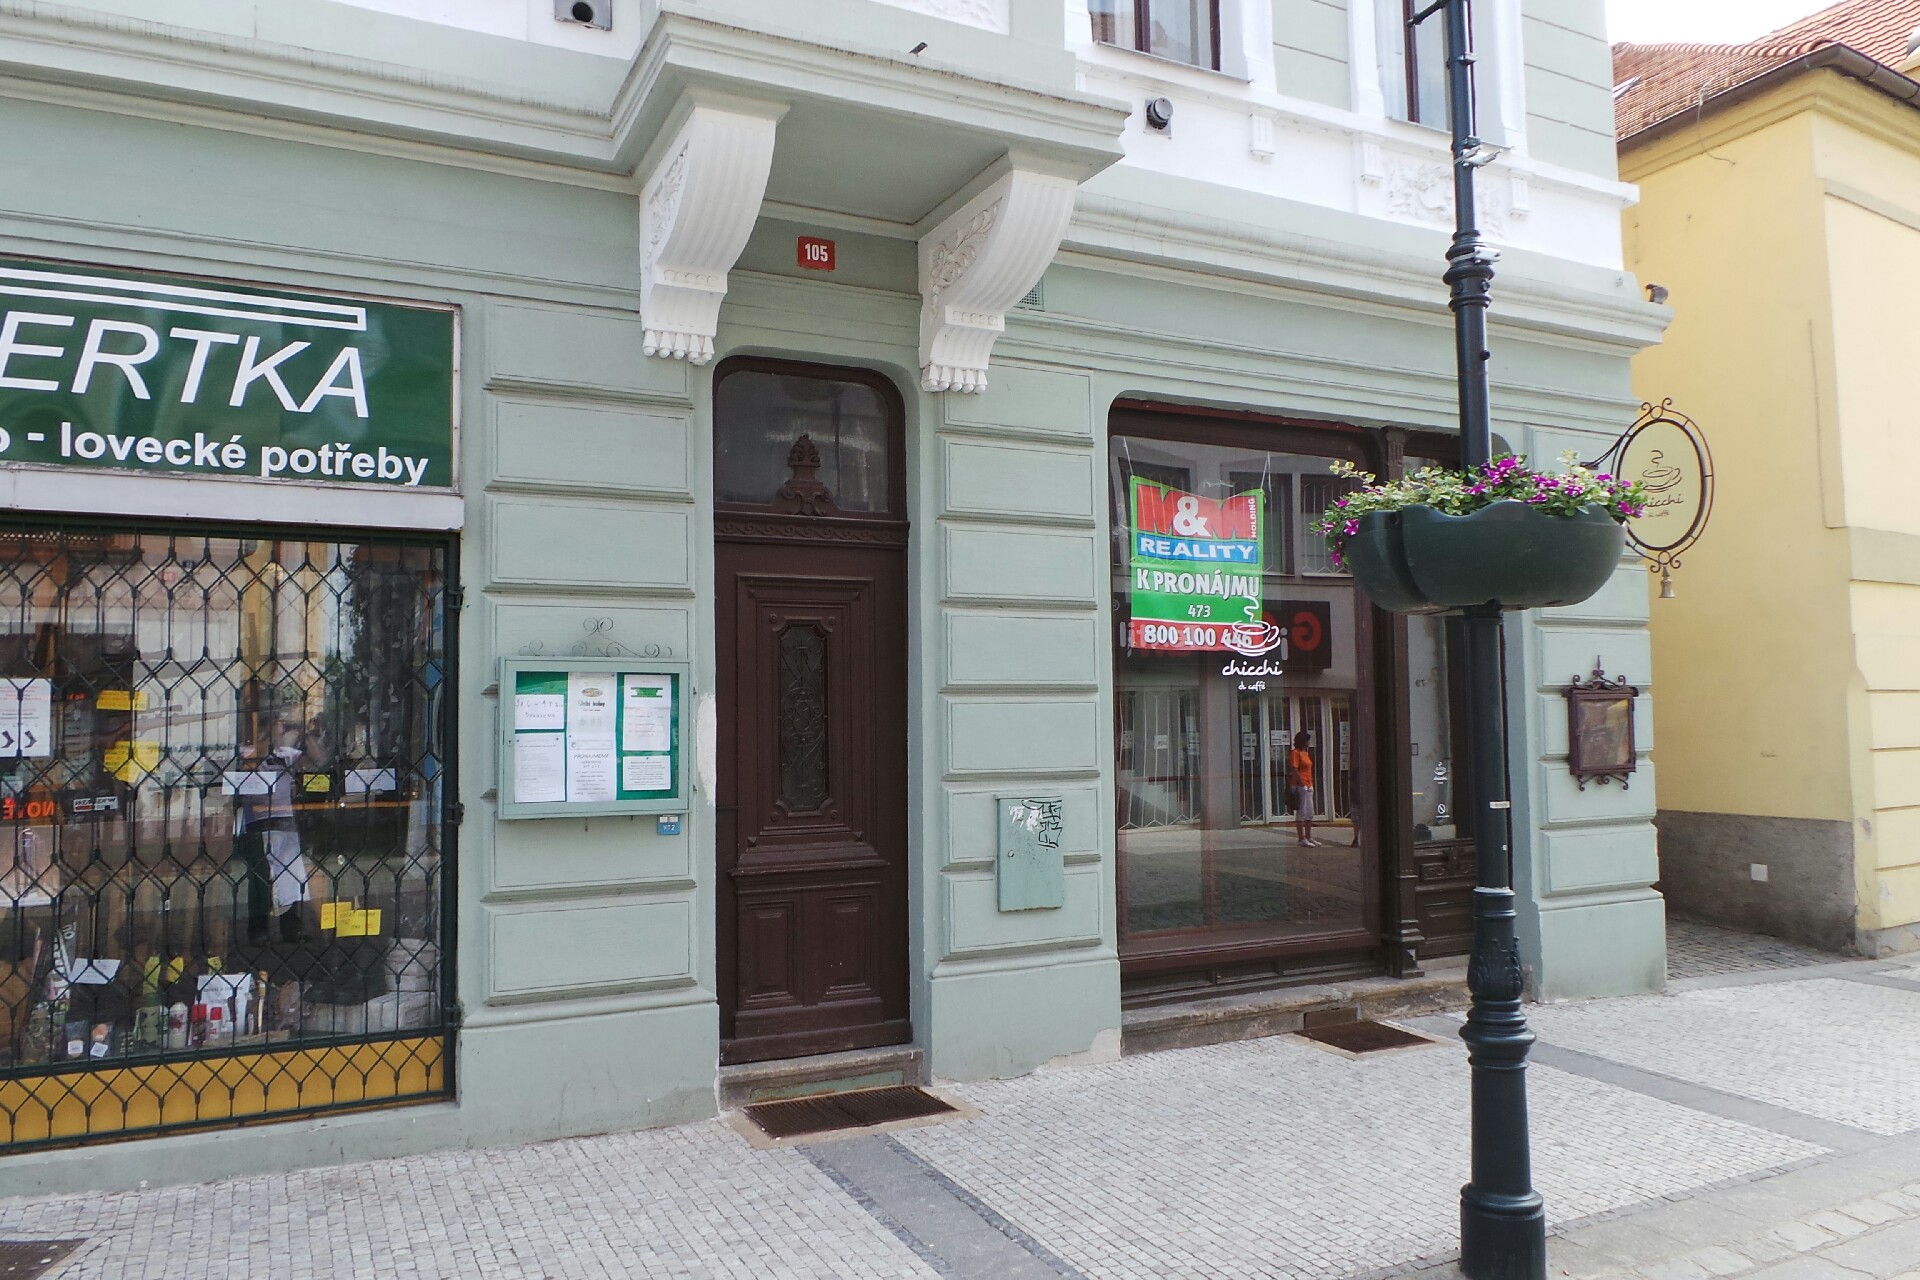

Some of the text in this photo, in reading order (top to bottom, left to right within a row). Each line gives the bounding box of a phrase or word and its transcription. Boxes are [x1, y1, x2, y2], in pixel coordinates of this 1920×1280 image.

[804, 243, 829, 262] 105
[0, 310, 369, 418] ERTKA
[61, 421, 247, 469] lovecké
[260, 442, 430, 486] potřeby
[1137, 484, 1252, 540] M&M
[1140, 537, 1255, 560] REALITY
[1152, 568, 1260, 601] PRONÁJMU
[1187, 603, 1211, 618] 473
[1143, 623, 1180, 646] 800
[1182, 626, 1217, 647] 100
[1222, 659, 1284, 676] chicchi
